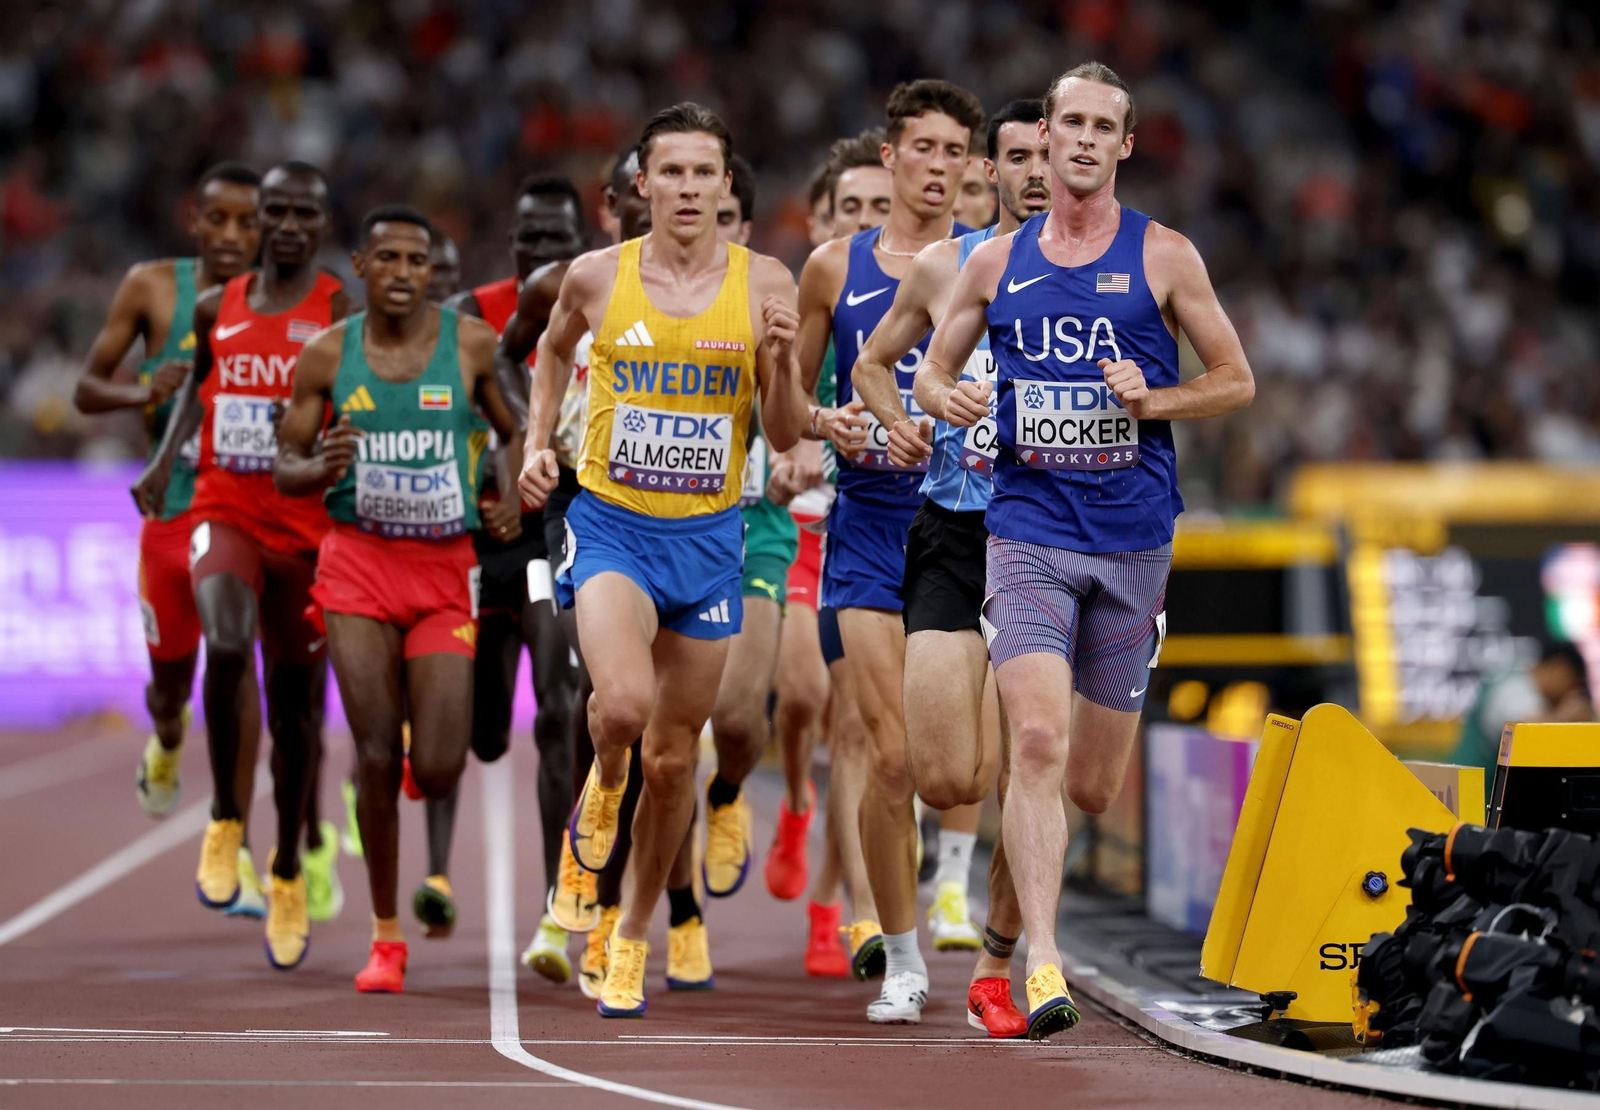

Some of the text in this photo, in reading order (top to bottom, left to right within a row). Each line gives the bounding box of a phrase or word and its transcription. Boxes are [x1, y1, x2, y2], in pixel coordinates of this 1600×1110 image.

[696, 341, 746, 351] BAUHAUS
[1014, 316, 1121, 363] USA
[217, 354, 297, 388] KENY
[612, 360, 741, 397] SWEDEN
[1044, 385, 1125, 411] TDK
[648, 413, 723, 440] TDK
[1022, 416, 1131, 445] HOCKER
[349, 429, 455, 462] THIOPIA
[615, 439, 724, 471] ALMGREN
[386, 467, 452, 493] TDK
[362, 493, 458, 518] GEBRHIWET
